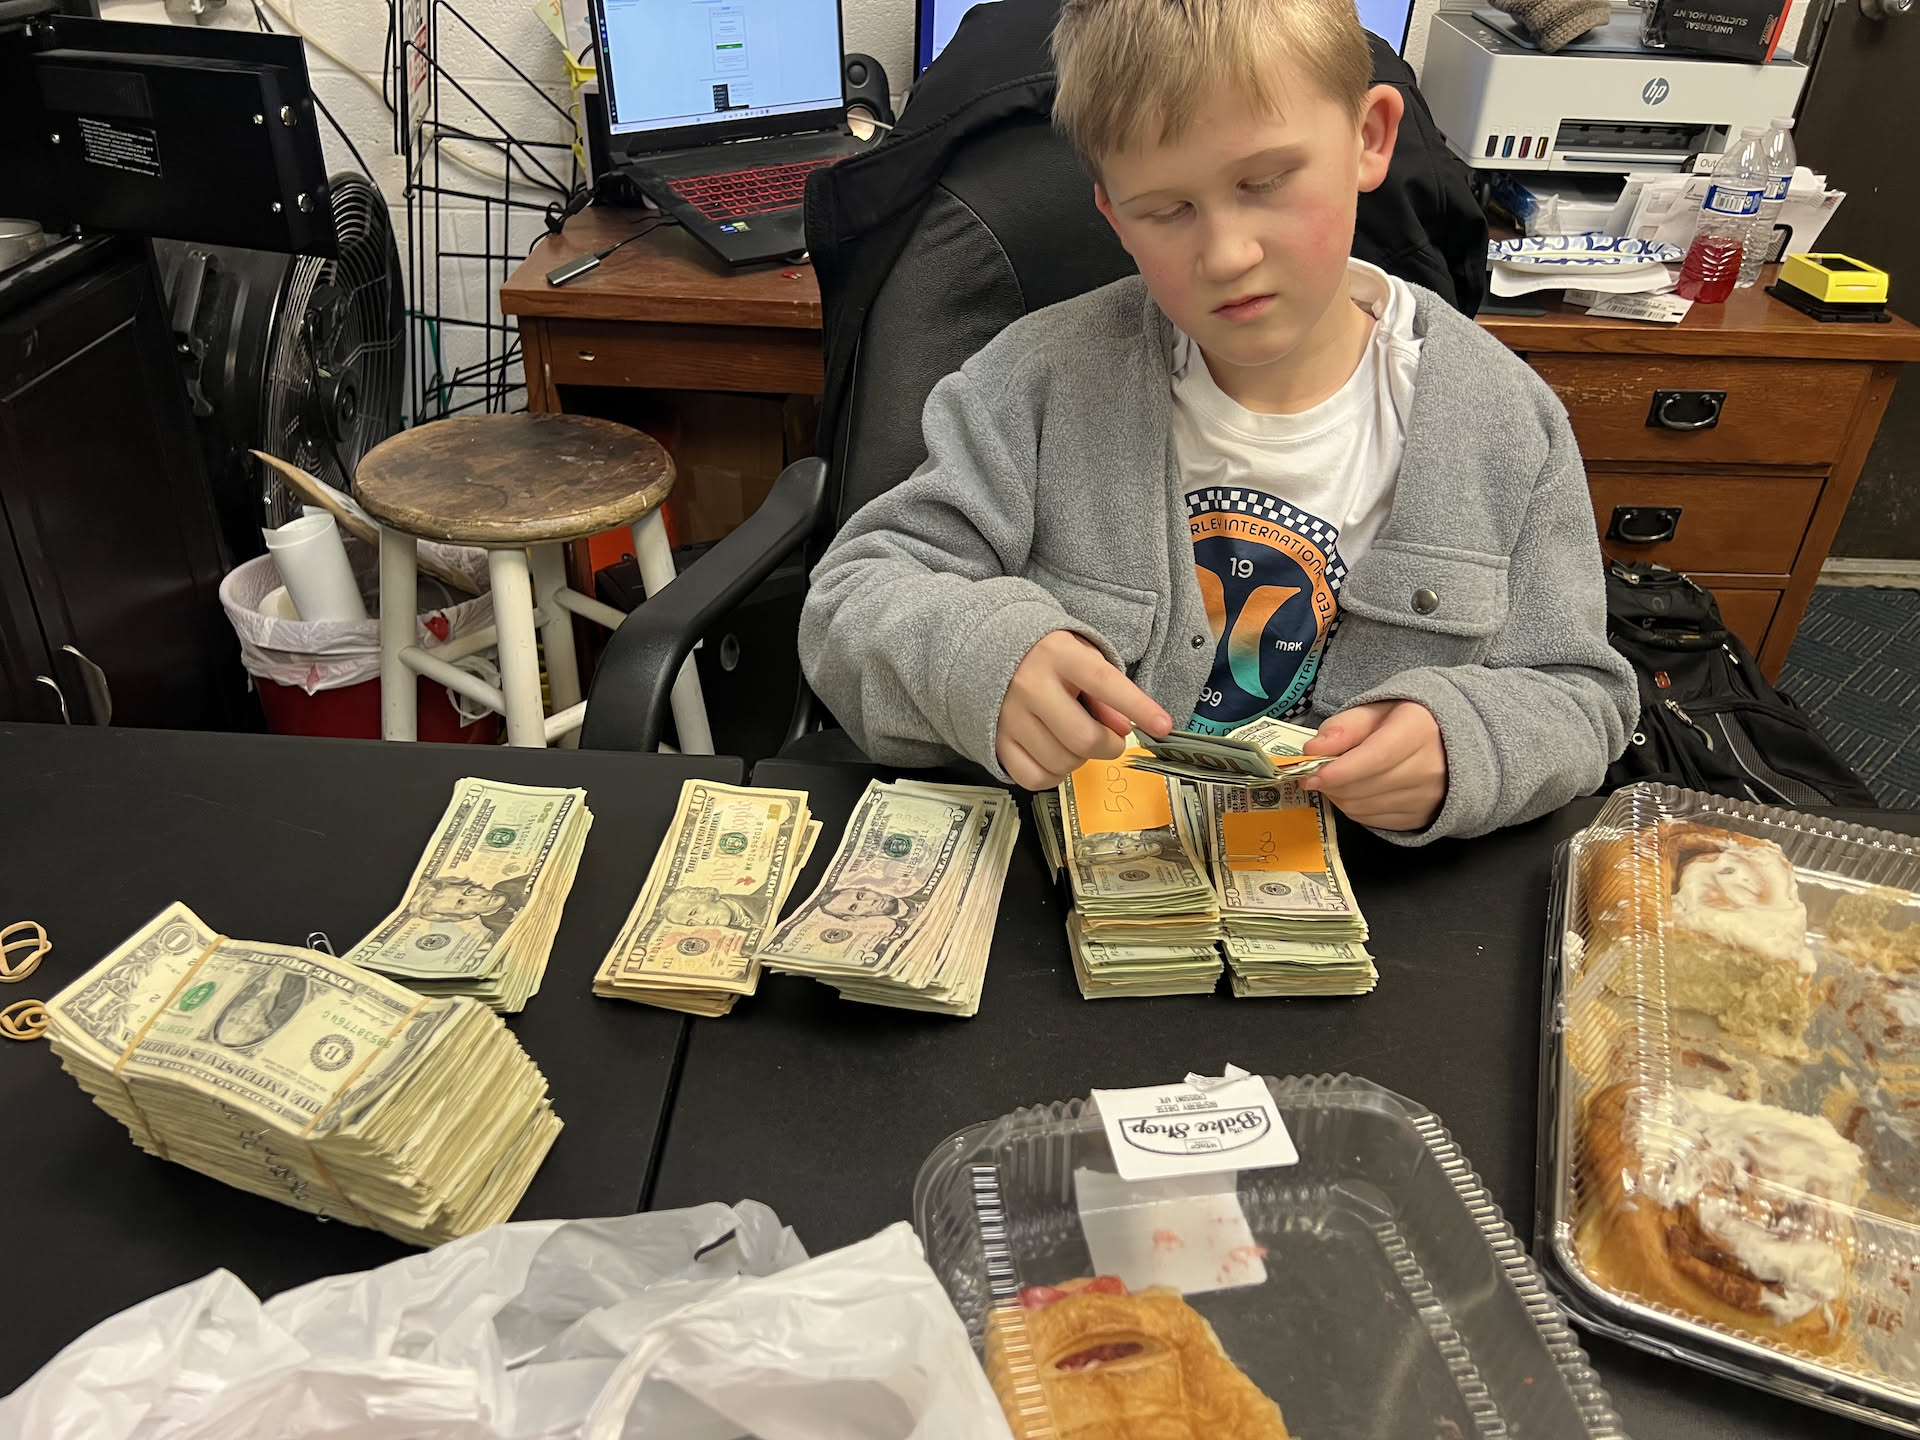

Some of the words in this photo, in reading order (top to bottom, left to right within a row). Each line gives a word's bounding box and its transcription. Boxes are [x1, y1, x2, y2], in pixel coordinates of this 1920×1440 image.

[1673, 8, 1706, 20] MOUNT
[1708, 13, 1748, 27] SUCTION
[1685, 21, 1734, 35] UNIVERSAL
[1644, 77, 1669, 106] hp
[1190, 518, 1222, 536] RLEY
[1224, 519, 1325, 577] INTERNATIONA
[1229, 557, 1254, 579] 19
[1187, 719, 1215, 736] ETY
[462, 784, 484, 807] 20
[867, 791, 882, 804] 5
[1103, 765, 1134, 813] 500
[688, 789, 708, 816] 10
[700, 795, 716, 825] STATES
[944, 806, 965, 822] 5
[691, 824, 706, 855] UNITED
[705, 810, 724, 848] AMERICA
[701, 846, 711, 860] OF
[1256, 830, 1279, 864] 500
[685, 853, 698, 874] THE
[922, 829, 959, 896] DOLLARS
[1082, 881, 1100, 896] 20
[1180, 868, 1203, 888] 20
[745, 928, 761, 947] TEN
[765, 834, 789, 898] DOLLARS
[1225, 887, 1242, 907] 50
[1323, 895, 1350, 912] 50
[352, 941, 385, 961] 20
[461, 942, 494, 973] 20
[625, 947, 647, 970] 10
[852, 949, 879, 964] 5
[249, 952, 313, 975] DOLLAR
[312, 967, 355, 991] ONE
[121, 1030, 174, 1055] AMERIA
[170, 1045, 189, 1058] OF
[323, 1044, 341, 1061] B
[188, 1047, 236, 1075] STATES
[234, 1064, 291, 1099] UNITED
[288, 1090, 323, 1115] THE
[1129, 1119, 1190, 1139] Shop
[1194, 1110, 1263, 1135] Bake
